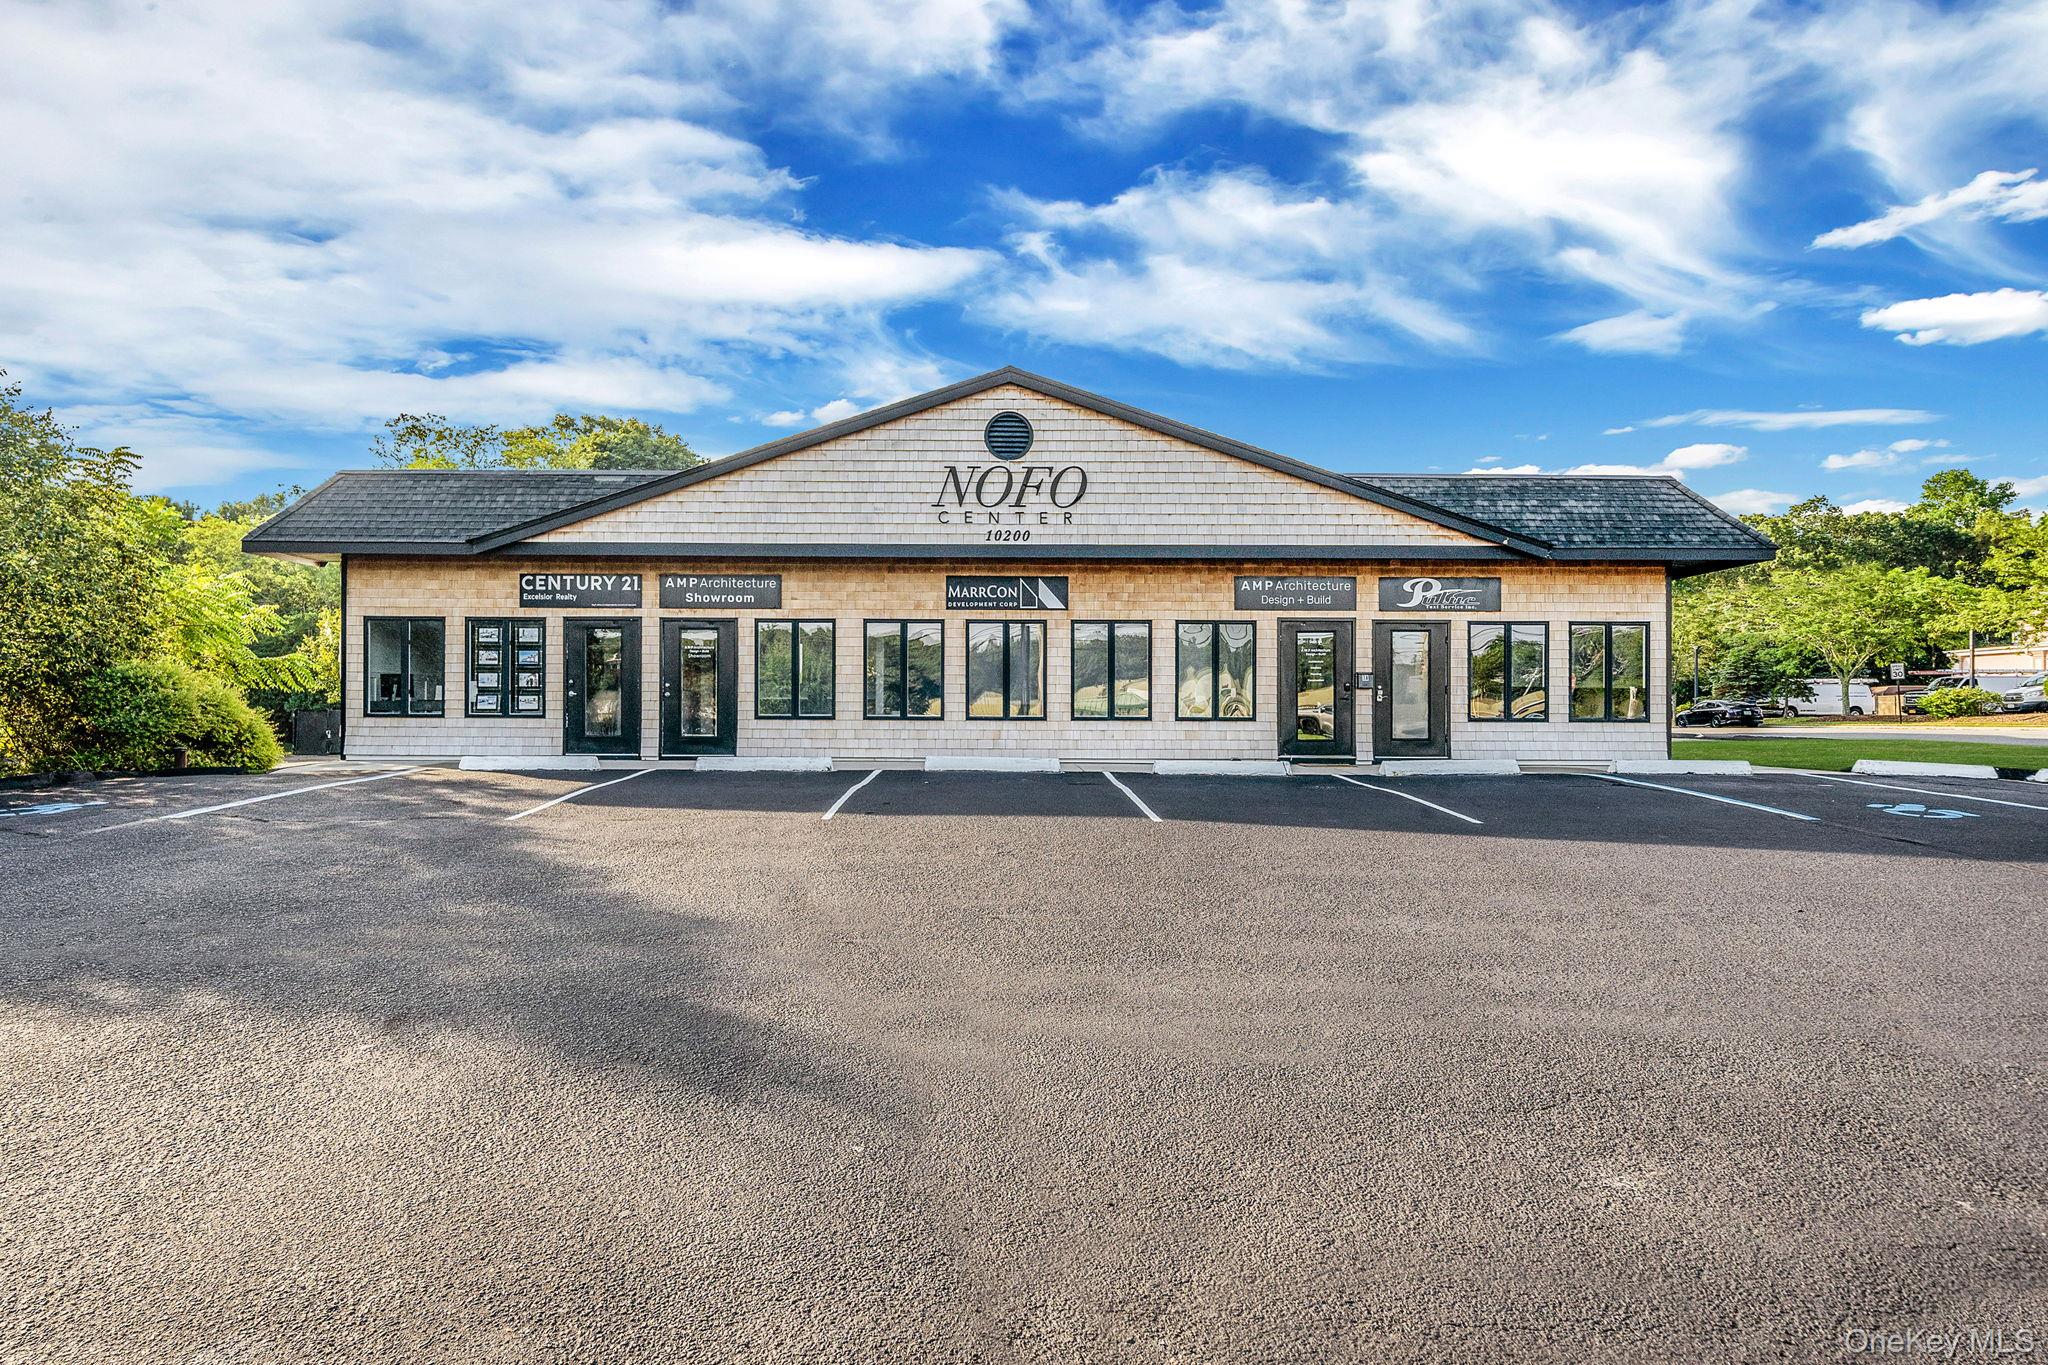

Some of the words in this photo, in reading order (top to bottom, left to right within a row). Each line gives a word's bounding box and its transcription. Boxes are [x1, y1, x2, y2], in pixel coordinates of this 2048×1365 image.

[931, 465, 1088, 509] NOFO
[938, 511, 1073, 525] CENTER
[985, 530, 1031, 542] 10200
[521, 575, 617, 591] CENTURY
[700, 577, 777, 589] Architecture
[1275, 580, 1351, 591] Architecture
[556, 593, 577, 602] Realty
[685, 592, 755, 603] Showroom
[1261, 595, 1295, 607] Design
[1306, 595, 1332, 605] Build
